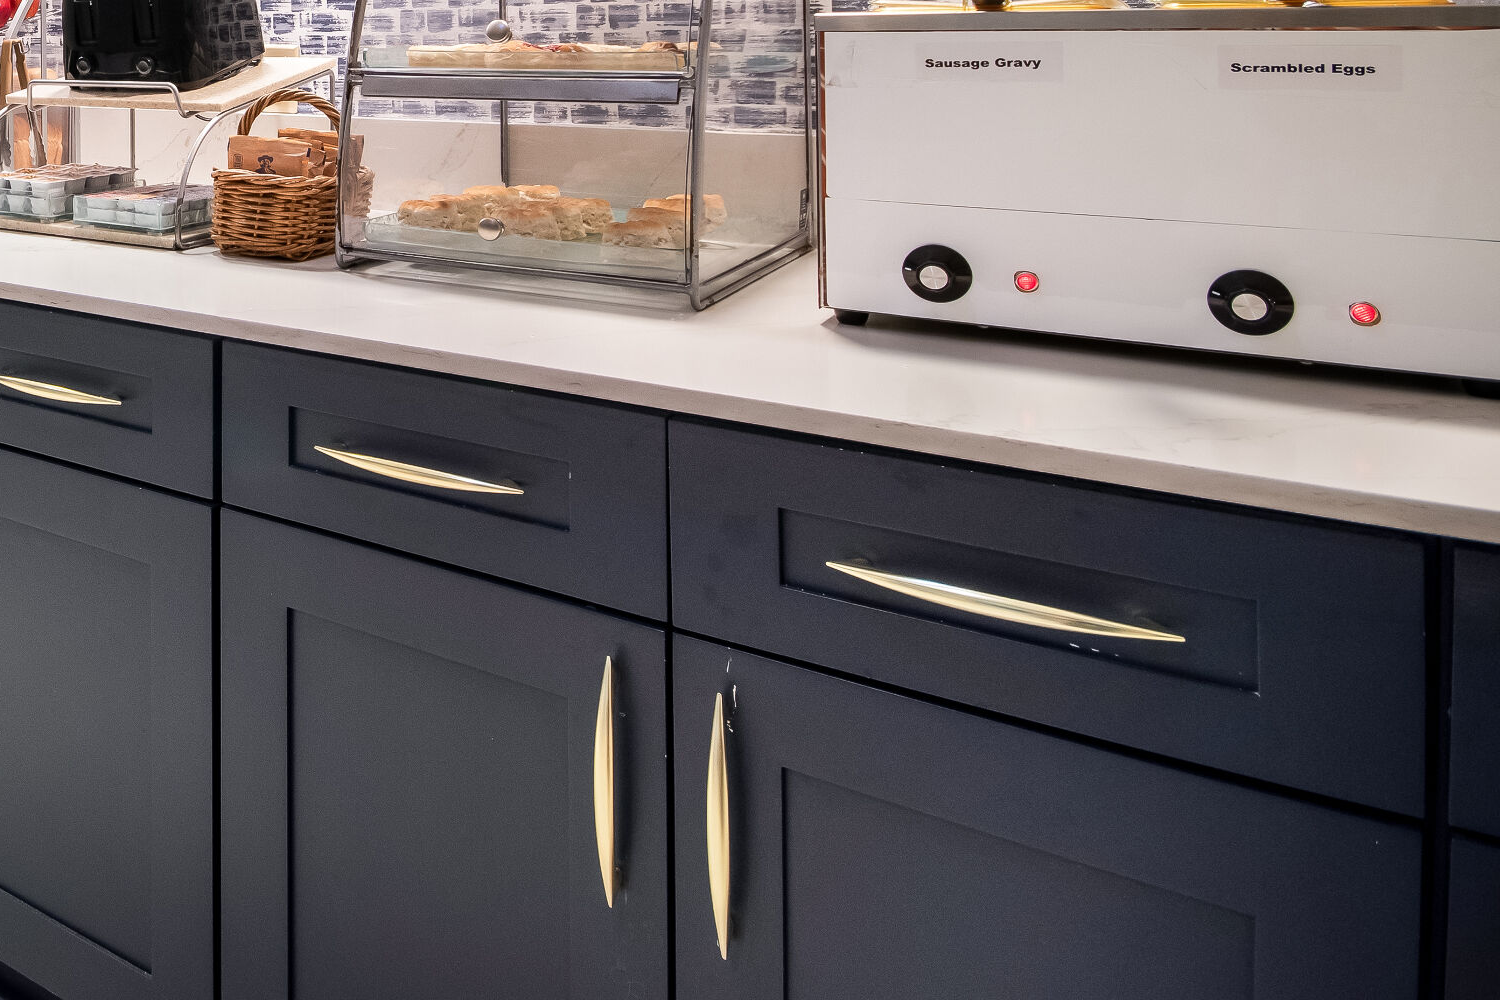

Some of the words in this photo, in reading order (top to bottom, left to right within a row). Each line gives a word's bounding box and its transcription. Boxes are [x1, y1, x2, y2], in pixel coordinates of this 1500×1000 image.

[924, 58, 990, 69] Sausage
[995, 57, 1042, 69] Gravy
[1230, 62, 1326, 74] Scrambled
[1331, 63, 1377, 76] Eggs
